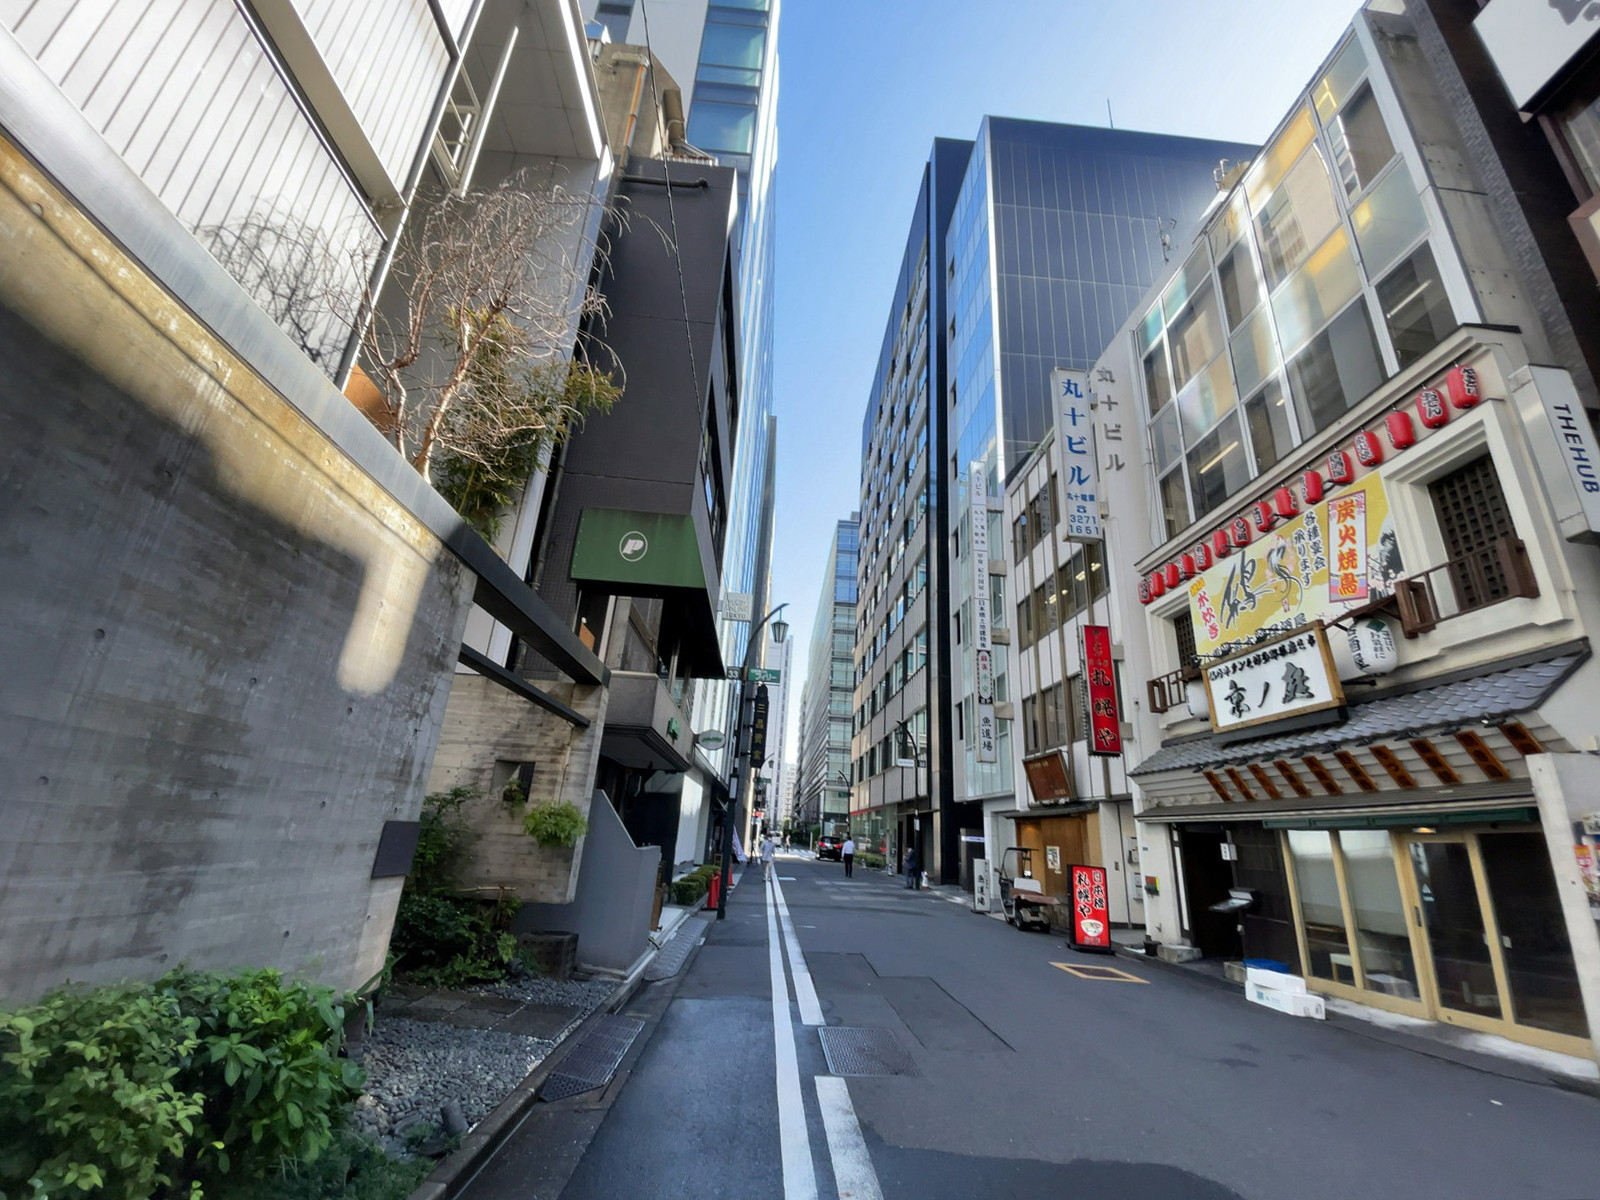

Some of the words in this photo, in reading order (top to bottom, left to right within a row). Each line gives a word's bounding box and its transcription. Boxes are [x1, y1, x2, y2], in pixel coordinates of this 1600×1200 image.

[1062, 378, 1091, 486] 丸十ビル
[1068, 524, 1099, 535] 1651
[1070, 514, 1097, 525] 3271
[1304, 511, 1326, 572] 各種宴会
[1293, 529, 1311, 587] 承ります
[1336, 498, 1359, 597] 炭火焼鳥
[1197, 591, 1219, 639] 水炊き
[727, 670, 739, 679] 33
[1091, 669, 1117, 748] 札幌や
[982, 716, 993, 752] 魚道場
[1076, 872, 1091, 917] 札幌や
[1093, 871, 1105, 909] 日本橋
